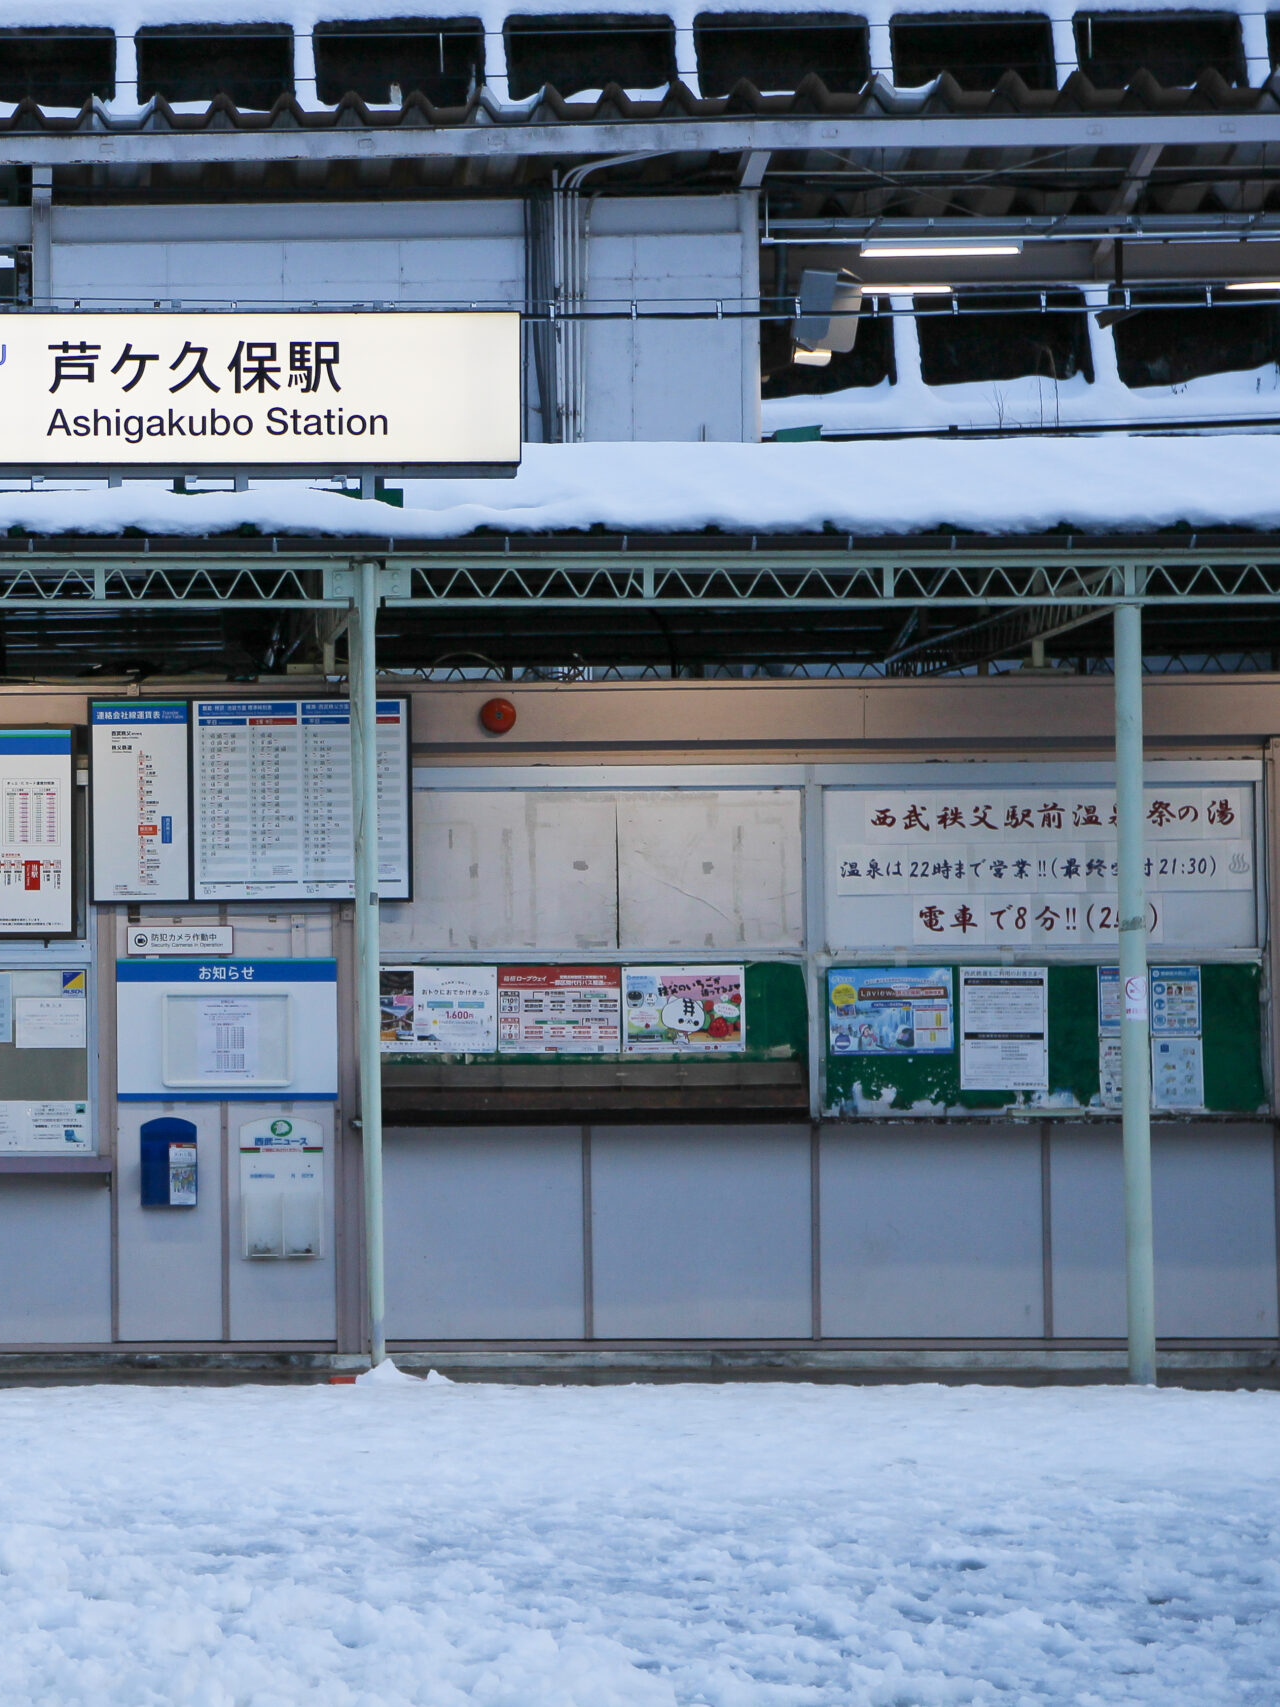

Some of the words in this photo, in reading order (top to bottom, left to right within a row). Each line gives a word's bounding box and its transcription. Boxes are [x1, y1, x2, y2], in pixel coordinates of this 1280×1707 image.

[46, 340, 342, 394] 芦ケ久保駅
[46, 408, 254, 443] Ashigakubo
[266, 408, 389, 437] Station
[151, 933, 217, 941] 防犯カメラ作動中
[198, 966, 255, 980] お知らせ
[255, 1137, 308, 1146] 西武ニュース
